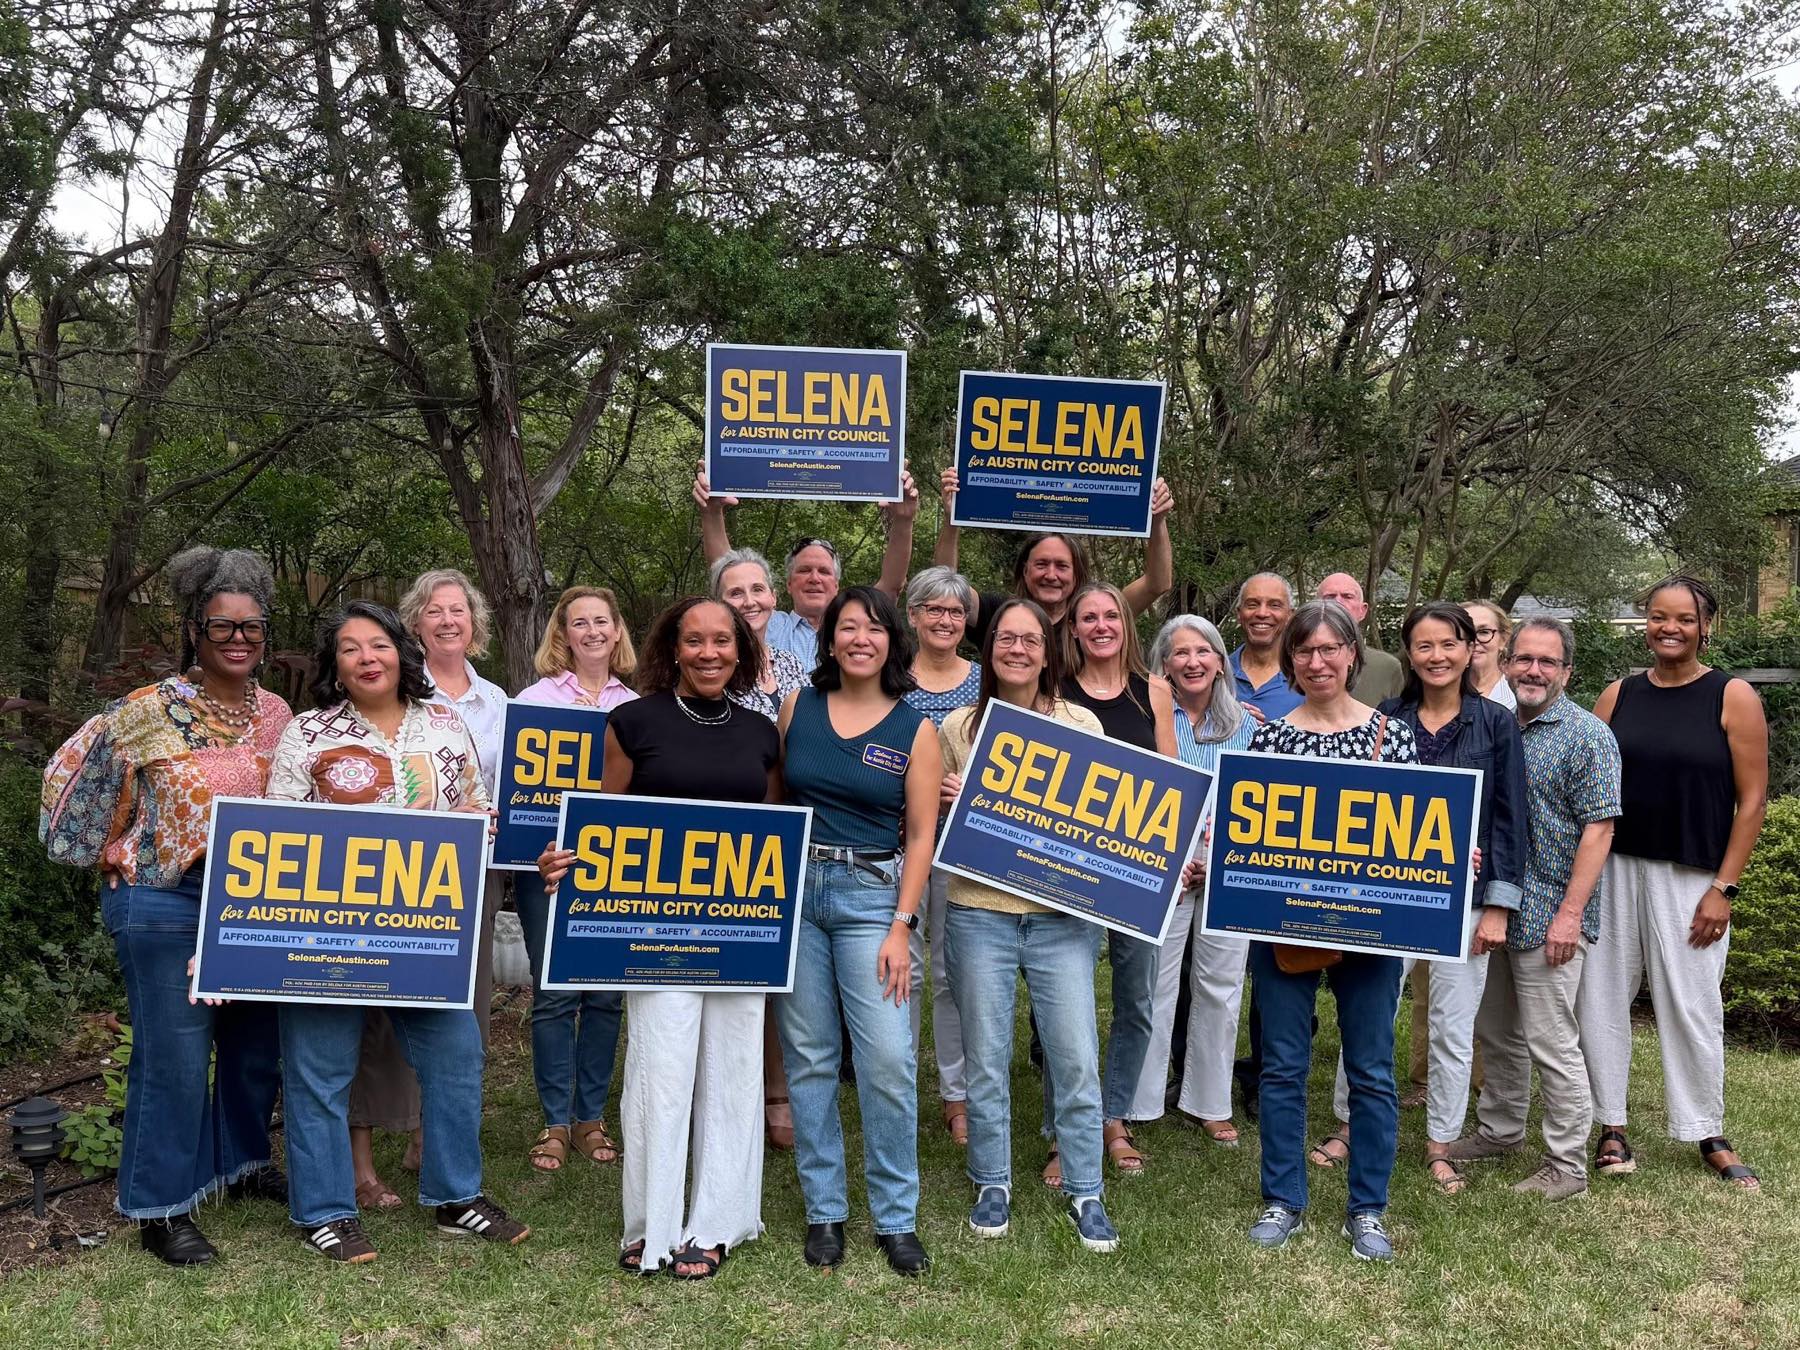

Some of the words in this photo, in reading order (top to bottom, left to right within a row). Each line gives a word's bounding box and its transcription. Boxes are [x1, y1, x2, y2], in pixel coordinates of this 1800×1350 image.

[721, 368, 890, 426] SELENA
[719, 425, 737, 439] for
[737, 426, 789, 439] AUSTIN
[791, 427, 825, 440] CITY
[827, 429, 890, 442] COUNCIL
[970, 396, 1144, 459] SELENA
[722, 446, 779, 454] AFFORDABILITY
[787, 448, 816, 456] SAFETY
[823, 449, 886, 458] ACCOUNTABILITY
[769, 461, 840, 469] SelenaForAustin.com
[967, 454, 985, 467] for
[985, 455, 1038, 470] AUSTIN
[1041, 459, 1075, 472] CITY
[1077, 461, 1142, 476] COUNCIL
[969, 475, 1027, 485] AFFORDABILITY
[1072, 482, 1137, 492] ACCOUNTABILITY
[1015, 491, 1088, 502] SelenaForAustin.com
[513, 727, 603, 790] SEL
[510, 790, 530, 805] for
[531, 792, 562, 806] AUS
[981, 731, 1181, 852] SELENA
[512, 814, 559, 823] AFFORDAB
[1228, 780, 1454, 864] SELENA
[970, 793, 991, 808] for
[991, 799, 1052, 830] AUSTIN
[1054, 820, 1095, 843] CITY
[1095, 835, 1168, 871] COUNCIL
[574, 824, 785, 898] SELENA
[968, 816, 1034, 844] AFFORDABILITY
[1042, 841, 1076, 858] SAFETY
[1084, 856, 1159, 887] ACCOUNTABILITY
[225, 830, 463, 909] SELENA
[1016, 849, 1099, 884] SelenaForAustin.com
[1223, 849, 1245, 865] for
[1247, 851, 1314, 871] AUSTIN
[1318, 858, 1363, 875] CITY
[1366, 863, 1452, 885] COUNCIL
[1226, 875, 1300, 889] AFFORDABILITY
[1311, 883, 1348, 894] SAFETY
[1359, 888, 1446, 904] ACCOUNTABILITY
[568, 897, 590, 914] for
[592, 898, 659, 914] AUSTIN
[662, 900, 704, 916] CITY
[707, 902, 782, 918] COUNCIL
[1285, 897, 1381, 914] SelenaForAustin.com
[219, 904, 244, 921] for
[245, 905, 319, 923] AUSTIN
[323, 909, 370, 925] CITY
[373, 912, 461, 930] COUNCIL
[222, 931, 304, 943] AFFORDABILITY
[315, 936, 355, 946] SAFETY
[366, 939, 454, 951] ACCOUNTABILITY
[570, 924, 645, 934] AFFORDABILITY
[655, 927, 690, 935] SAFETY
[700, 928, 777, 938] ACCOUNTABILITY
[287, 952, 389, 965] SelenaForAustin.com
[629, 943, 719, 953] SelenaForAustin.com
